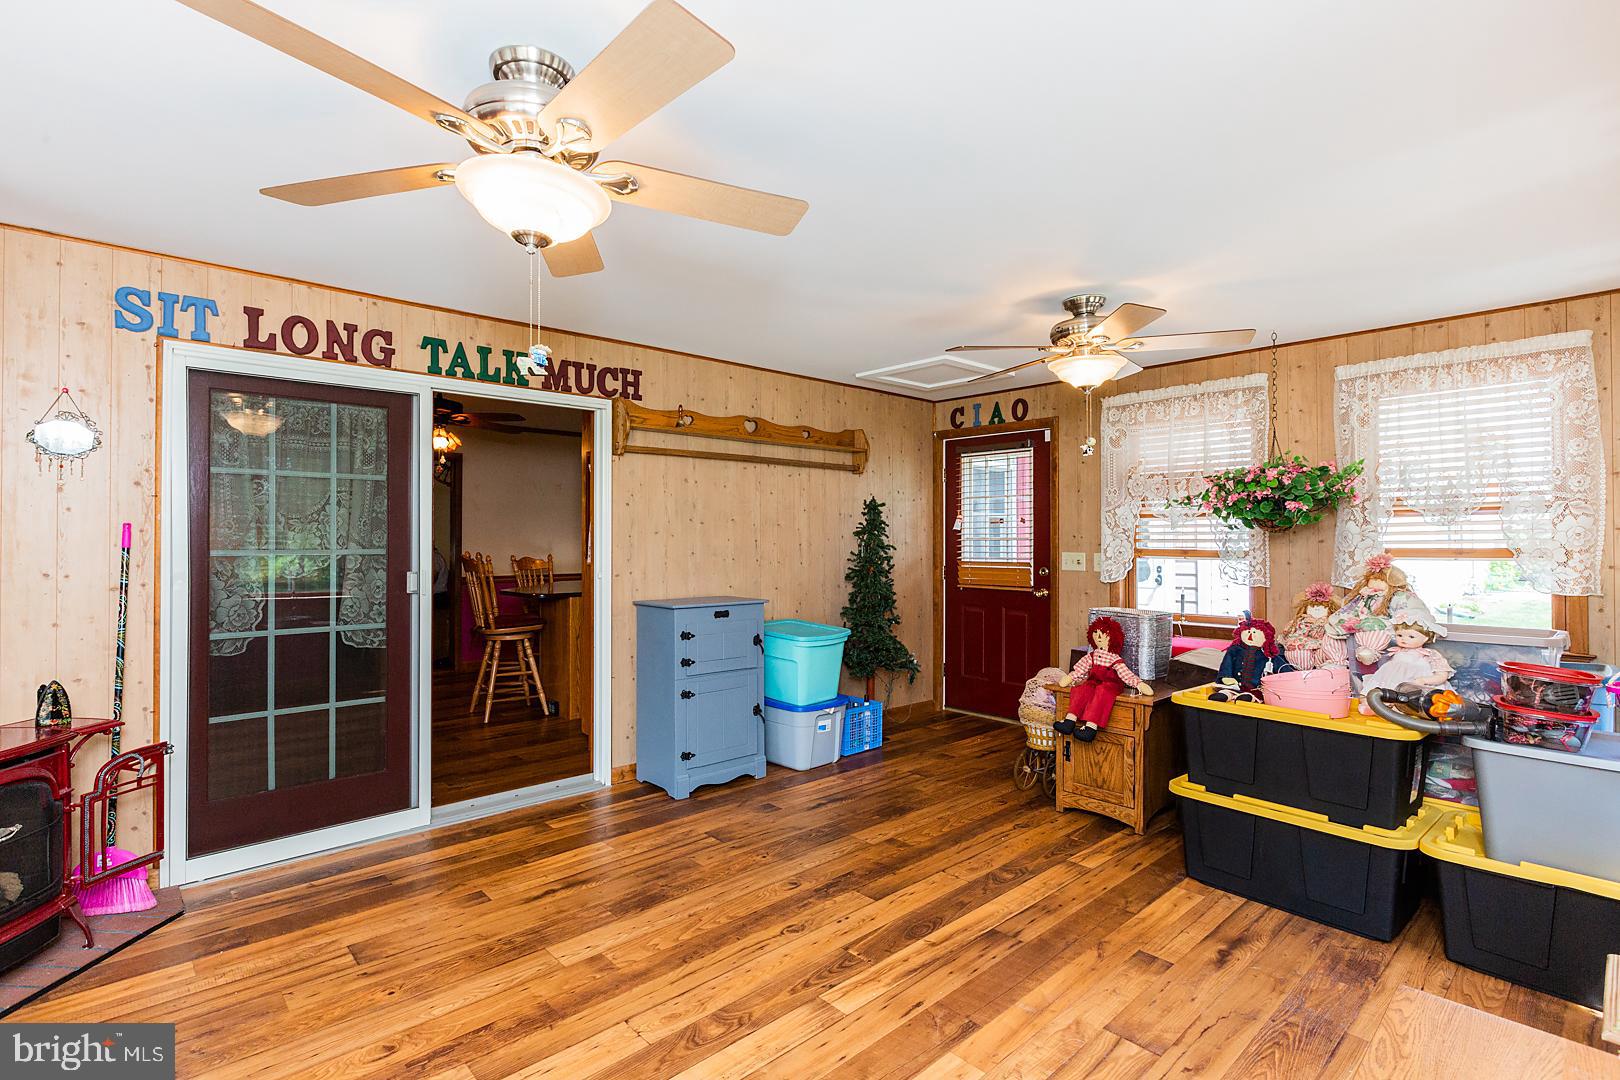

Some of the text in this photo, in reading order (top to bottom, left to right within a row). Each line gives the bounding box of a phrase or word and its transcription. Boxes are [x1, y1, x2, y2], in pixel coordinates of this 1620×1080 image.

[114, 285, 643, 402] SIT LONG TALK MUCH
[950, 398, 1029, 429] CIAO
